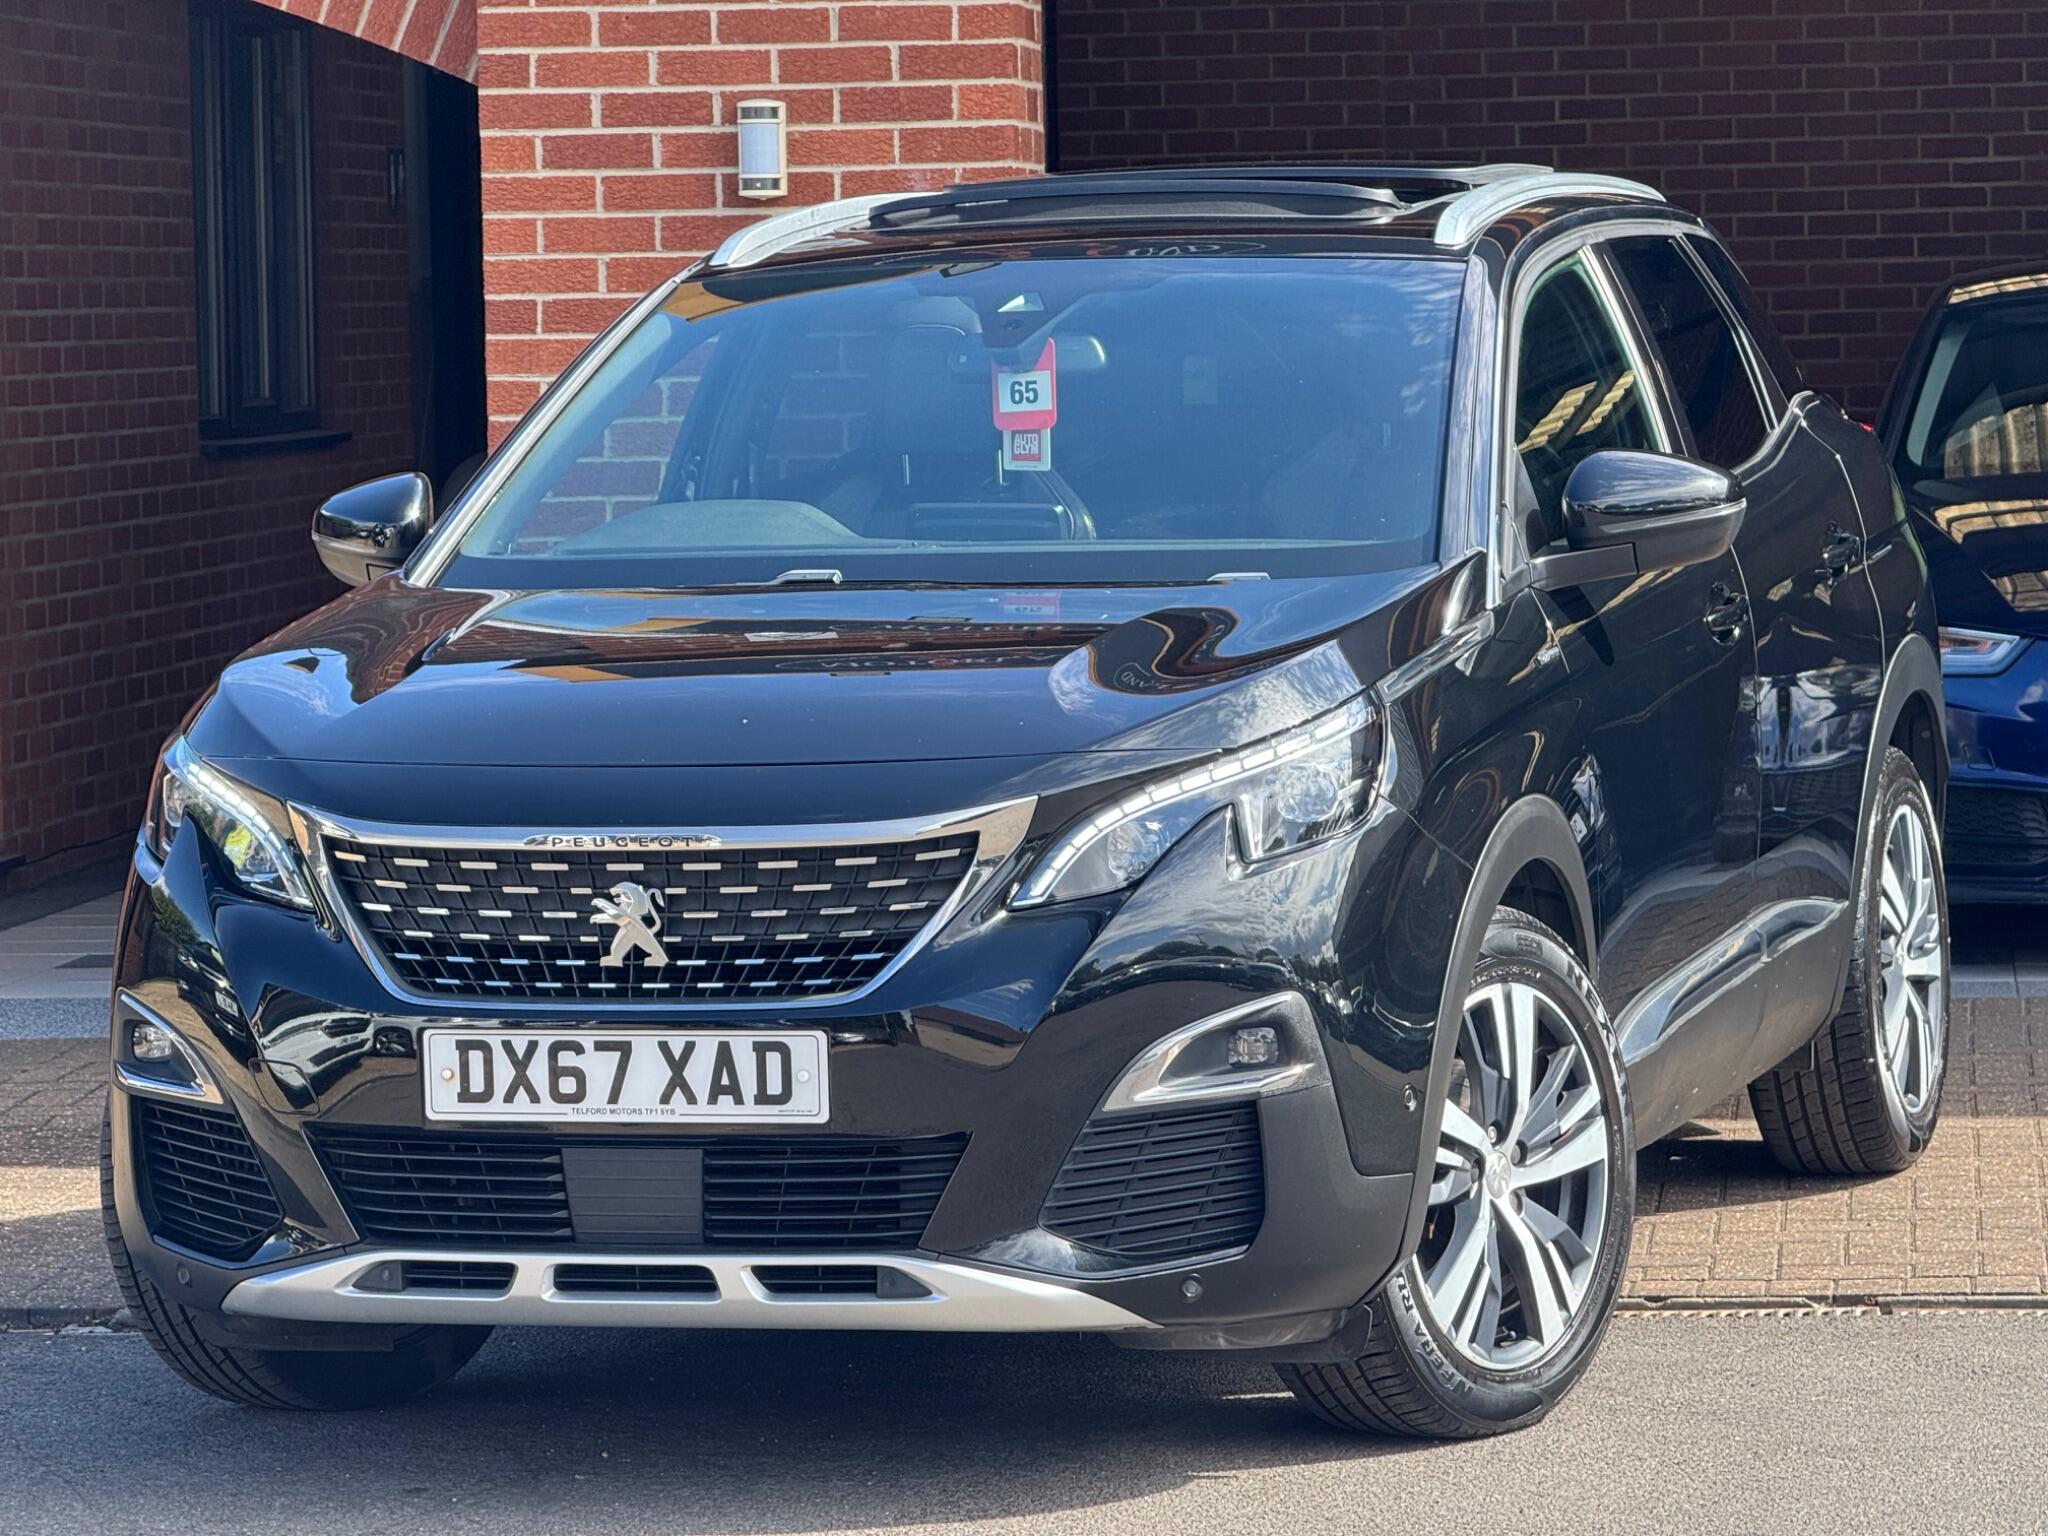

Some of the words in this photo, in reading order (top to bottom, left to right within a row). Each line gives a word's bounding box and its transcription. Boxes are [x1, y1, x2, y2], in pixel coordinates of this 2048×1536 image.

[1010, 380, 1039, 405] 65
[1014, 433, 1039, 444] AUTO
[1014, 442, 1039, 454] GLYM
[552, 837, 695, 847] PEUGEOT
[455, 1039, 633, 1105] DX67
[657, 1040, 793, 1106] XAD
[571, 1107, 608, 1115] TELFORD
